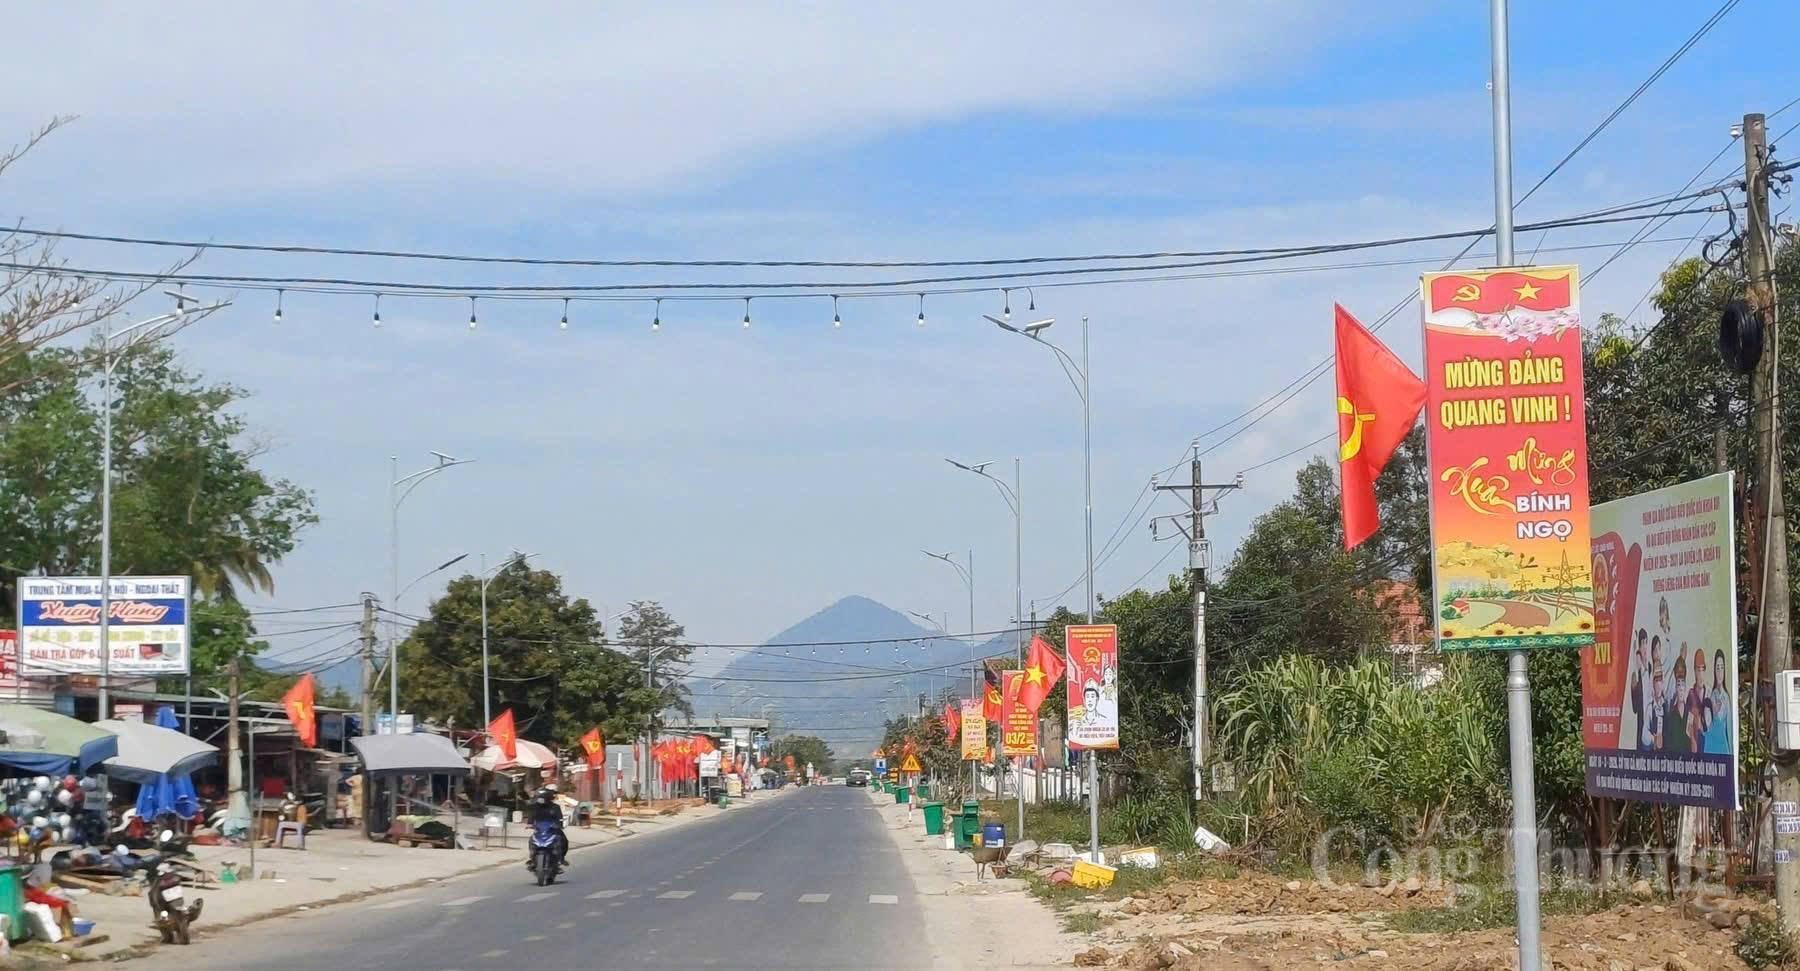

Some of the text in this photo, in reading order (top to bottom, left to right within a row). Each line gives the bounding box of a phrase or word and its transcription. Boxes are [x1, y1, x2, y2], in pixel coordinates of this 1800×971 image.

[1445, 349, 1564, 389] MỪNG ĐẢNG
[1440, 394, 1571, 430] QUANG VINH !
[1506, 437, 1576, 486] Mừng
[1515, 491, 1571, 513] BÍNH
[1516, 519, 1573, 542] NGỌ
[30, 584, 54, 595] TRUNG
[57, 583, 73, 595] TÂM
[1595, 641, 1612, 665] XVI
